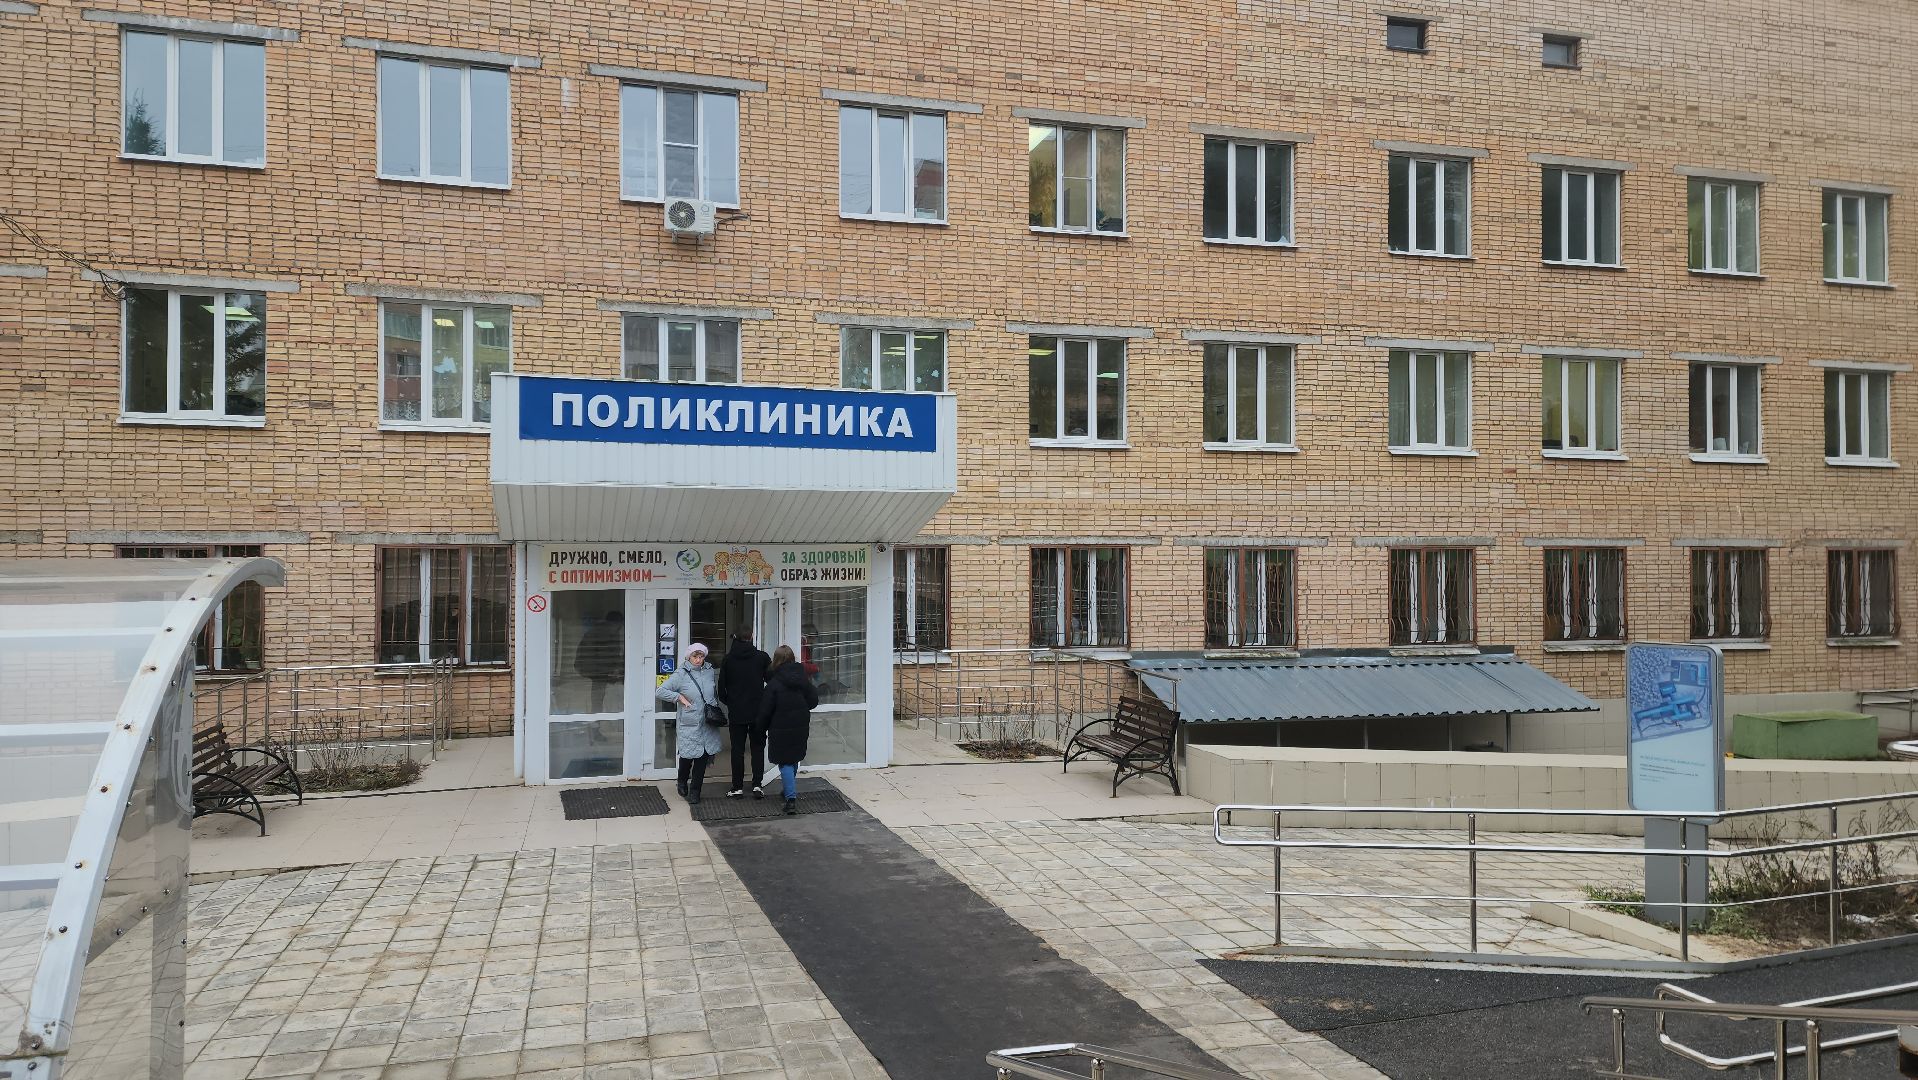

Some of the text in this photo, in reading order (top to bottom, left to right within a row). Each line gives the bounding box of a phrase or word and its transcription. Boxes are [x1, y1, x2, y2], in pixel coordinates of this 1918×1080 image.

[552, 392, 914, 439] ПОЛИКЛИНИКА
[549, 550, 667, 567] ДРУЖНО, СМЕЛО,
[781, 548, 866, 565] ЗА ЗДОРОВЫЙ
[548, 570, 557, 584] С
[780, 567, 866, 581] ОБРАЗ ЖИЗНИ!
